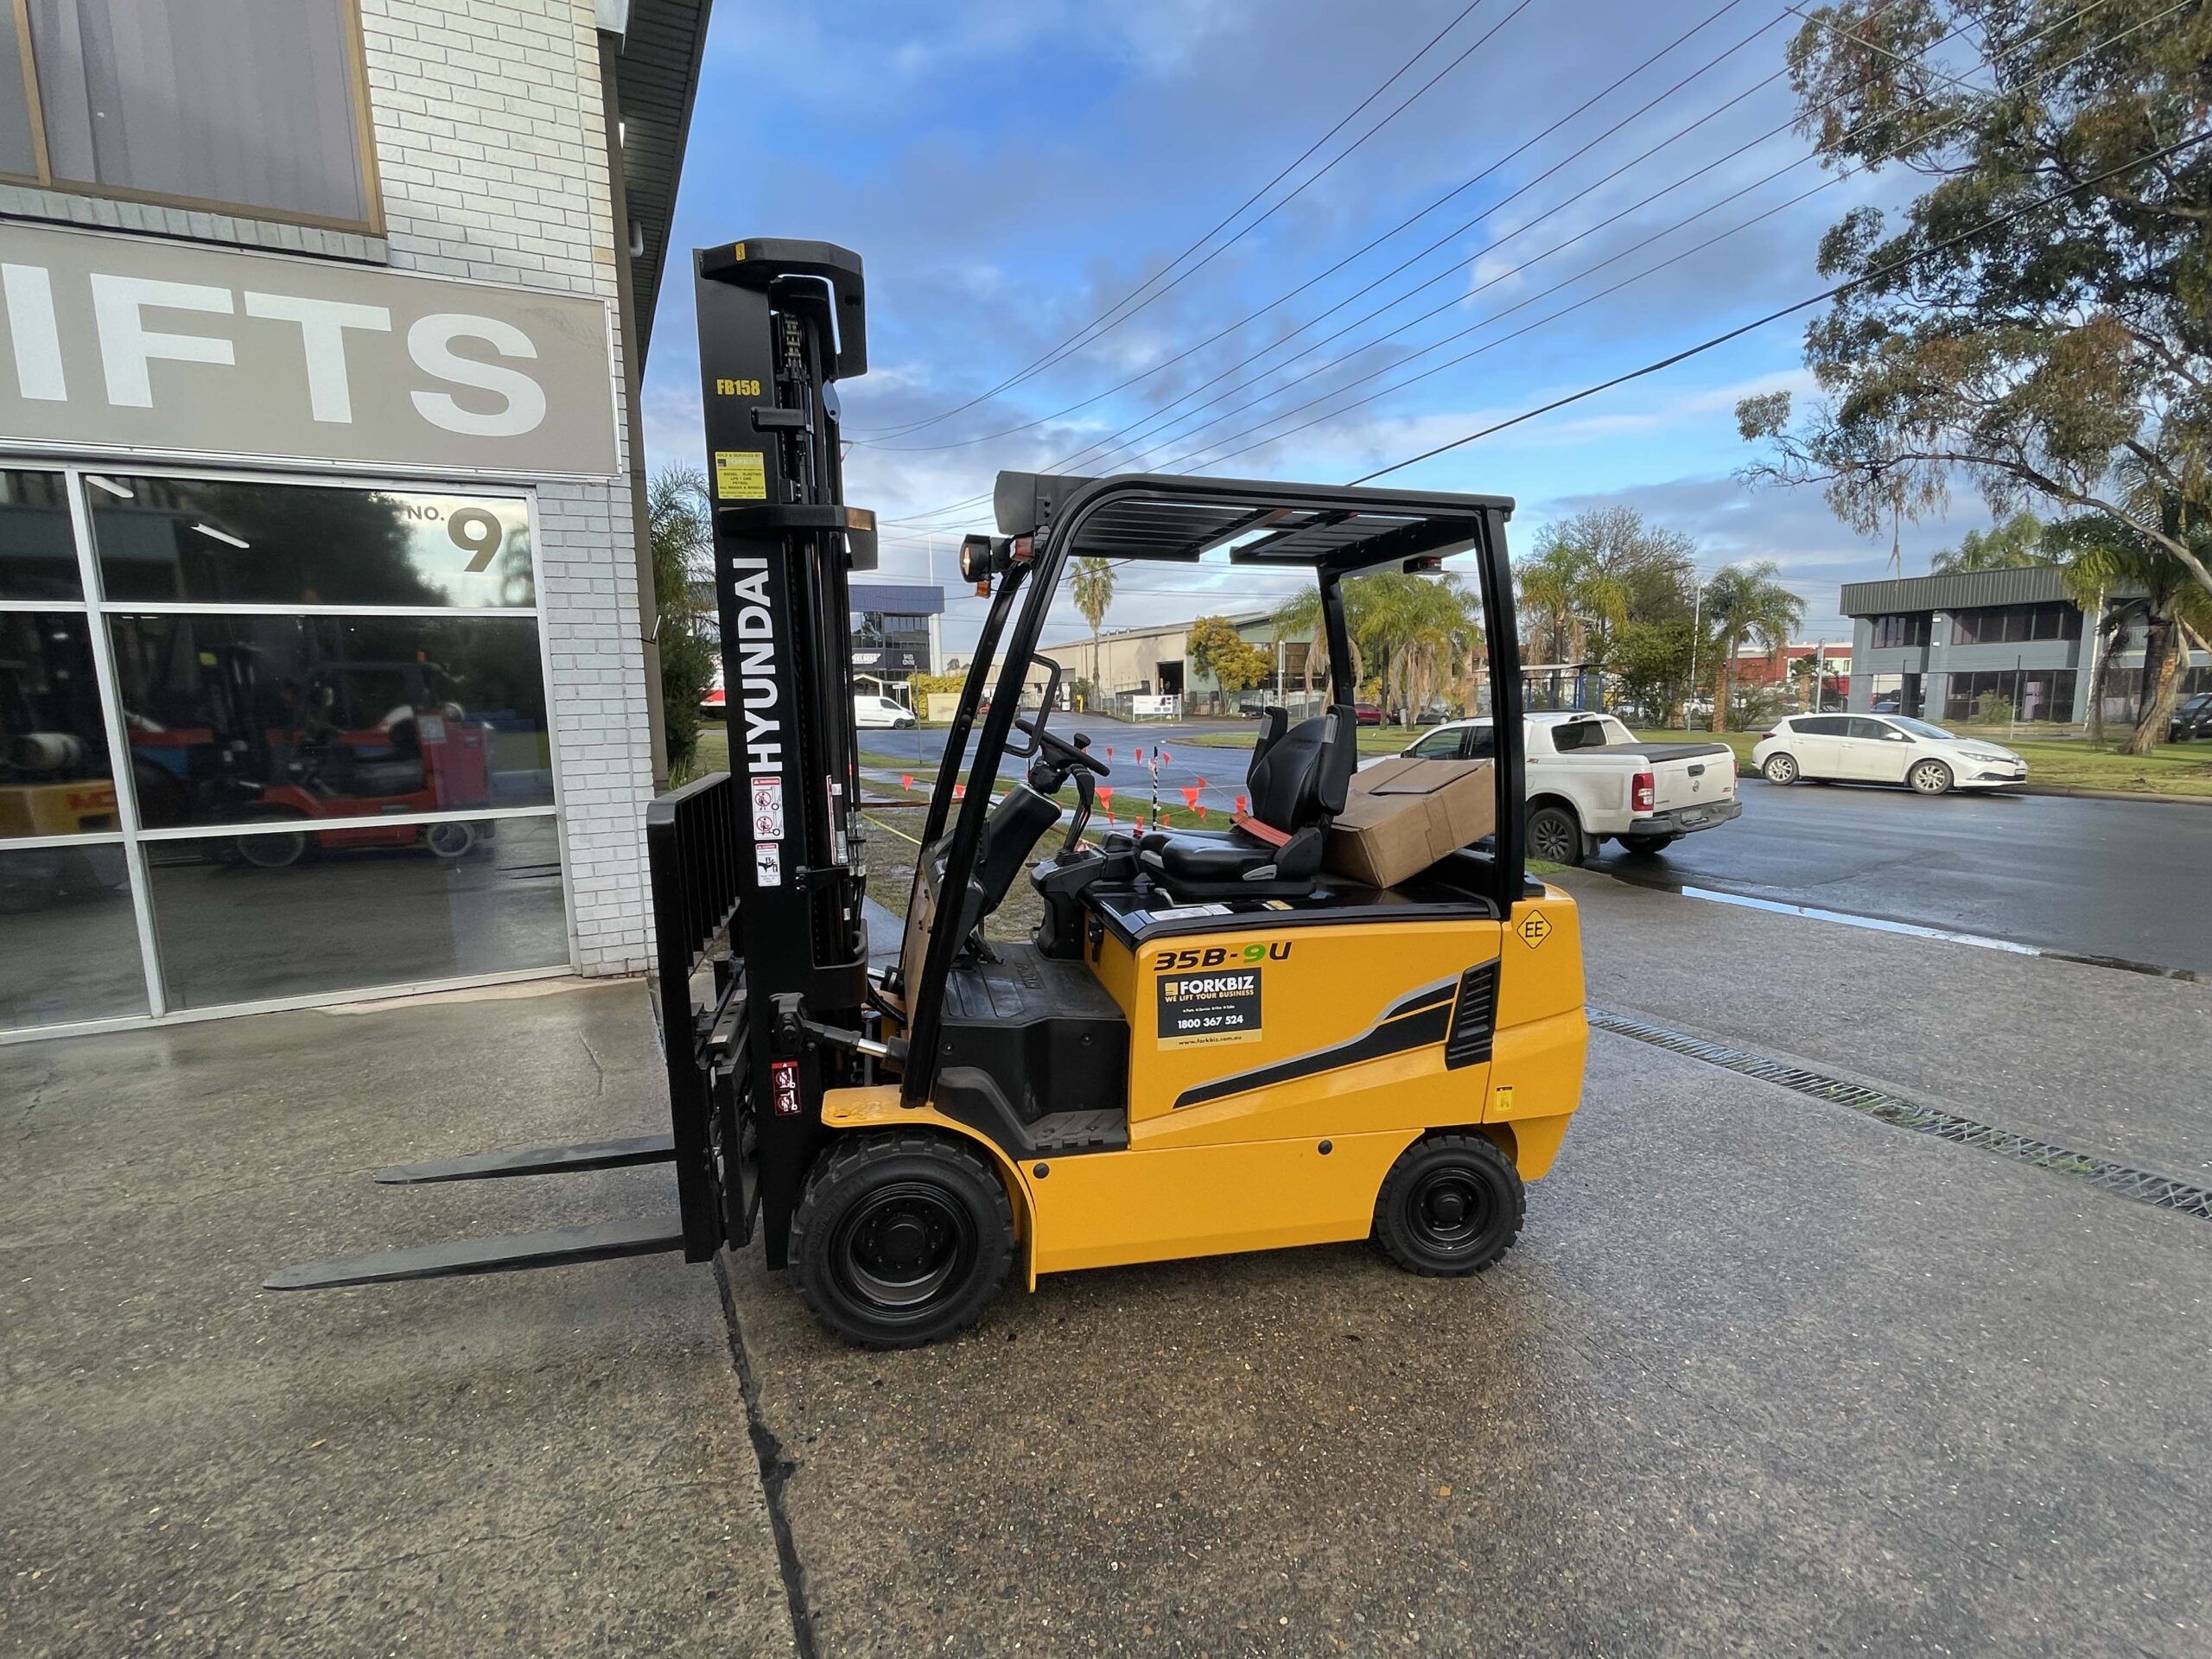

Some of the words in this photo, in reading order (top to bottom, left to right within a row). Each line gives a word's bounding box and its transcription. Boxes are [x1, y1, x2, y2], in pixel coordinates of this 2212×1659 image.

[1, 264, 547, 437] IFTS
[716, 378, 761, 396] FB158
[406, 505, 445, 522] NO.
[448, 507, 503, 573] 9
[733, 557, 783, 772] HYUNDAI
[1524, 920, 1544, 938] EE
[1154, 941, 1293, 971] 35B-9U
[1179, 976, 1255, 995] FORKBIZ
[1196, 992, 1217, 1001] YOUR
[1219, 989, 1255, 999] BUSINESS
[1178, 1018, 1201, 1030] 1800
[1203, 1016, 1223, 1027] 367
[1225, 1014, 1244, 1025] 524
[1179, 1035, 1243, 1046] www.forkbiz.com.au
